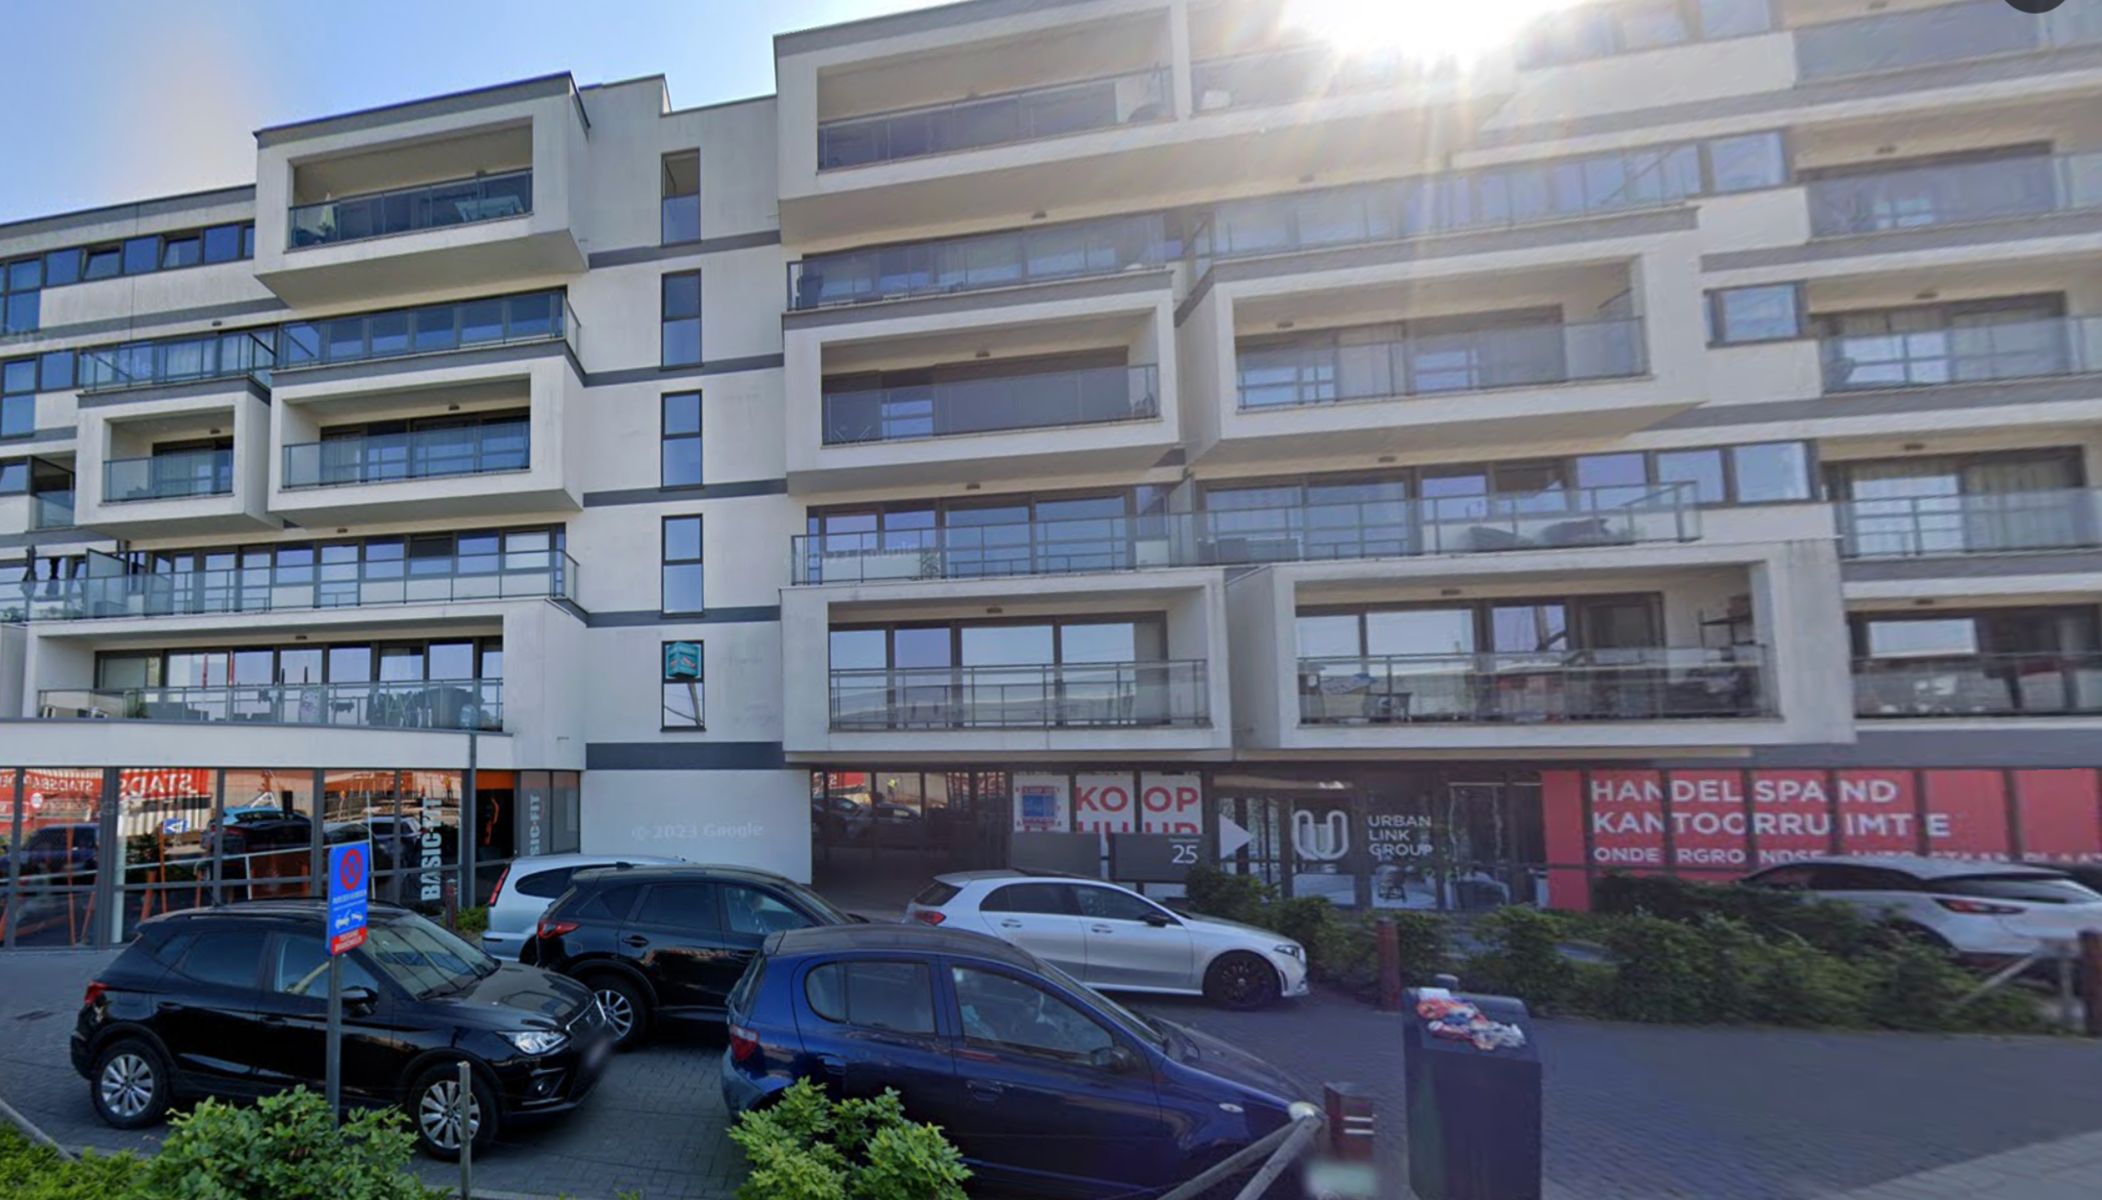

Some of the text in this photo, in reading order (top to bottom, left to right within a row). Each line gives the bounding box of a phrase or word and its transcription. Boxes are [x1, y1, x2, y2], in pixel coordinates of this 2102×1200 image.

[1367, 814, 1433, 829] URBAN
[1367, 829, 1410, 842] LINK
[1171, 844, 1199, 864] 25
[1367, 843, 1435, 857] GROUP
